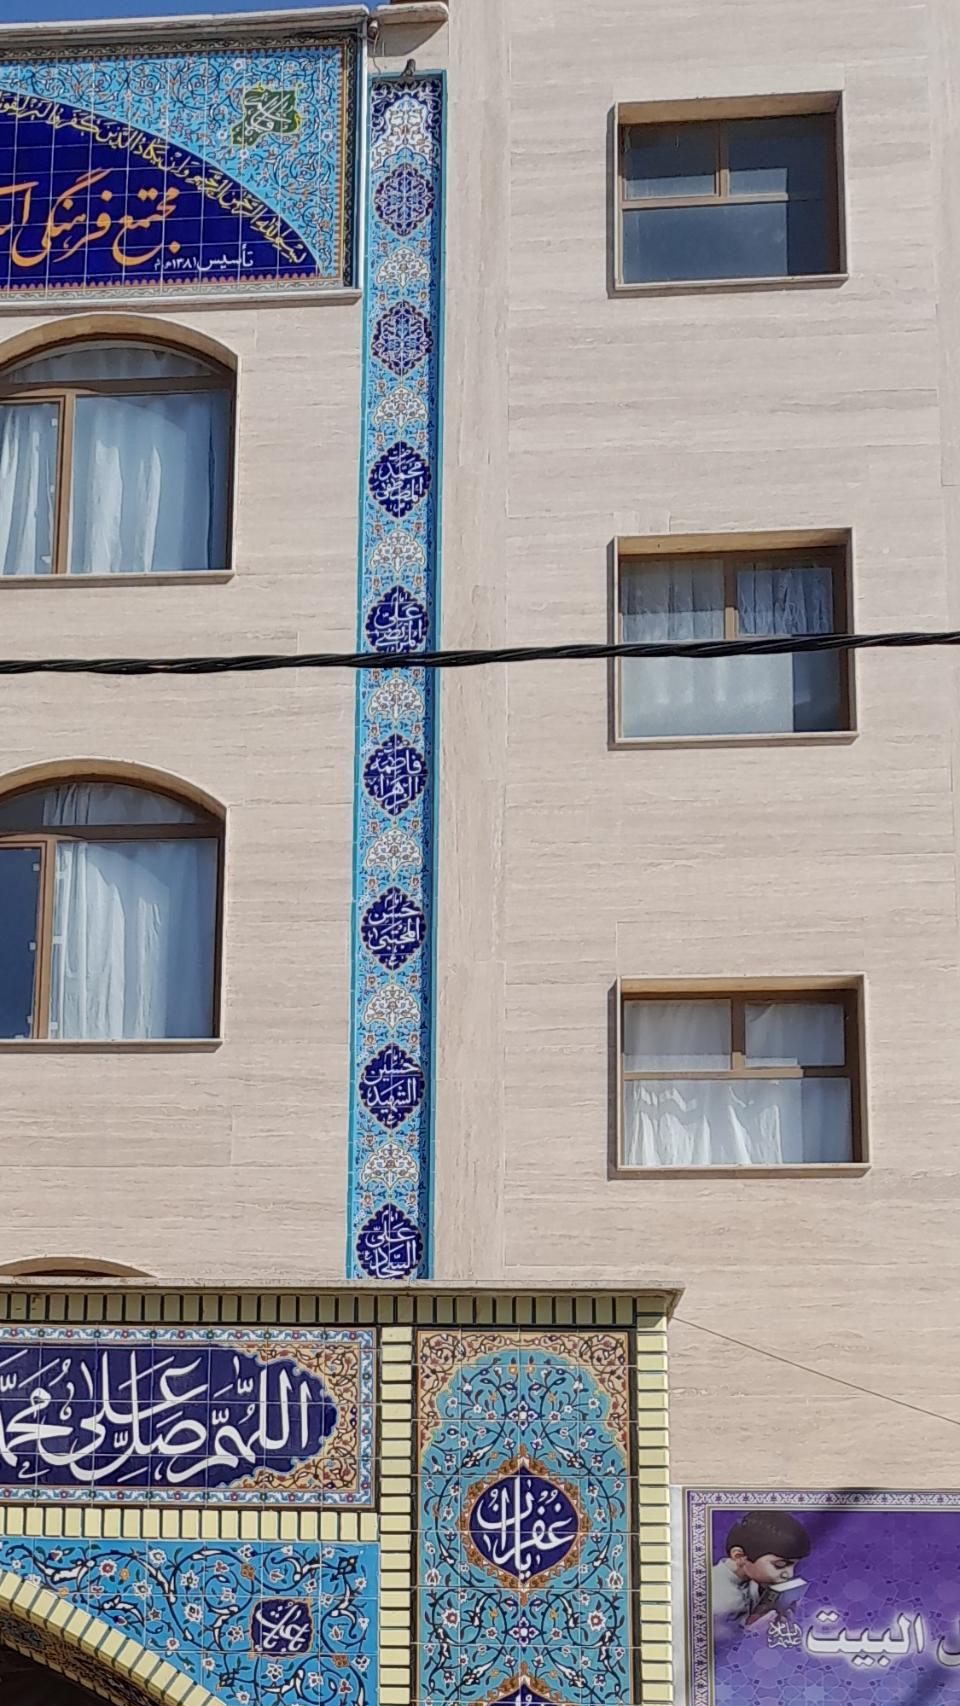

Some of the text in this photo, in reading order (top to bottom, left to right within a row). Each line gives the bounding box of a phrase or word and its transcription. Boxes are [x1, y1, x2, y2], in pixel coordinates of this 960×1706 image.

[11, 167, 114, 267] فرهنگی
[112, 186, 180, 266] مجتمع
[170, 1366, 311, 1483] اللهم
[806, 1610, 927, 1668] البیت
